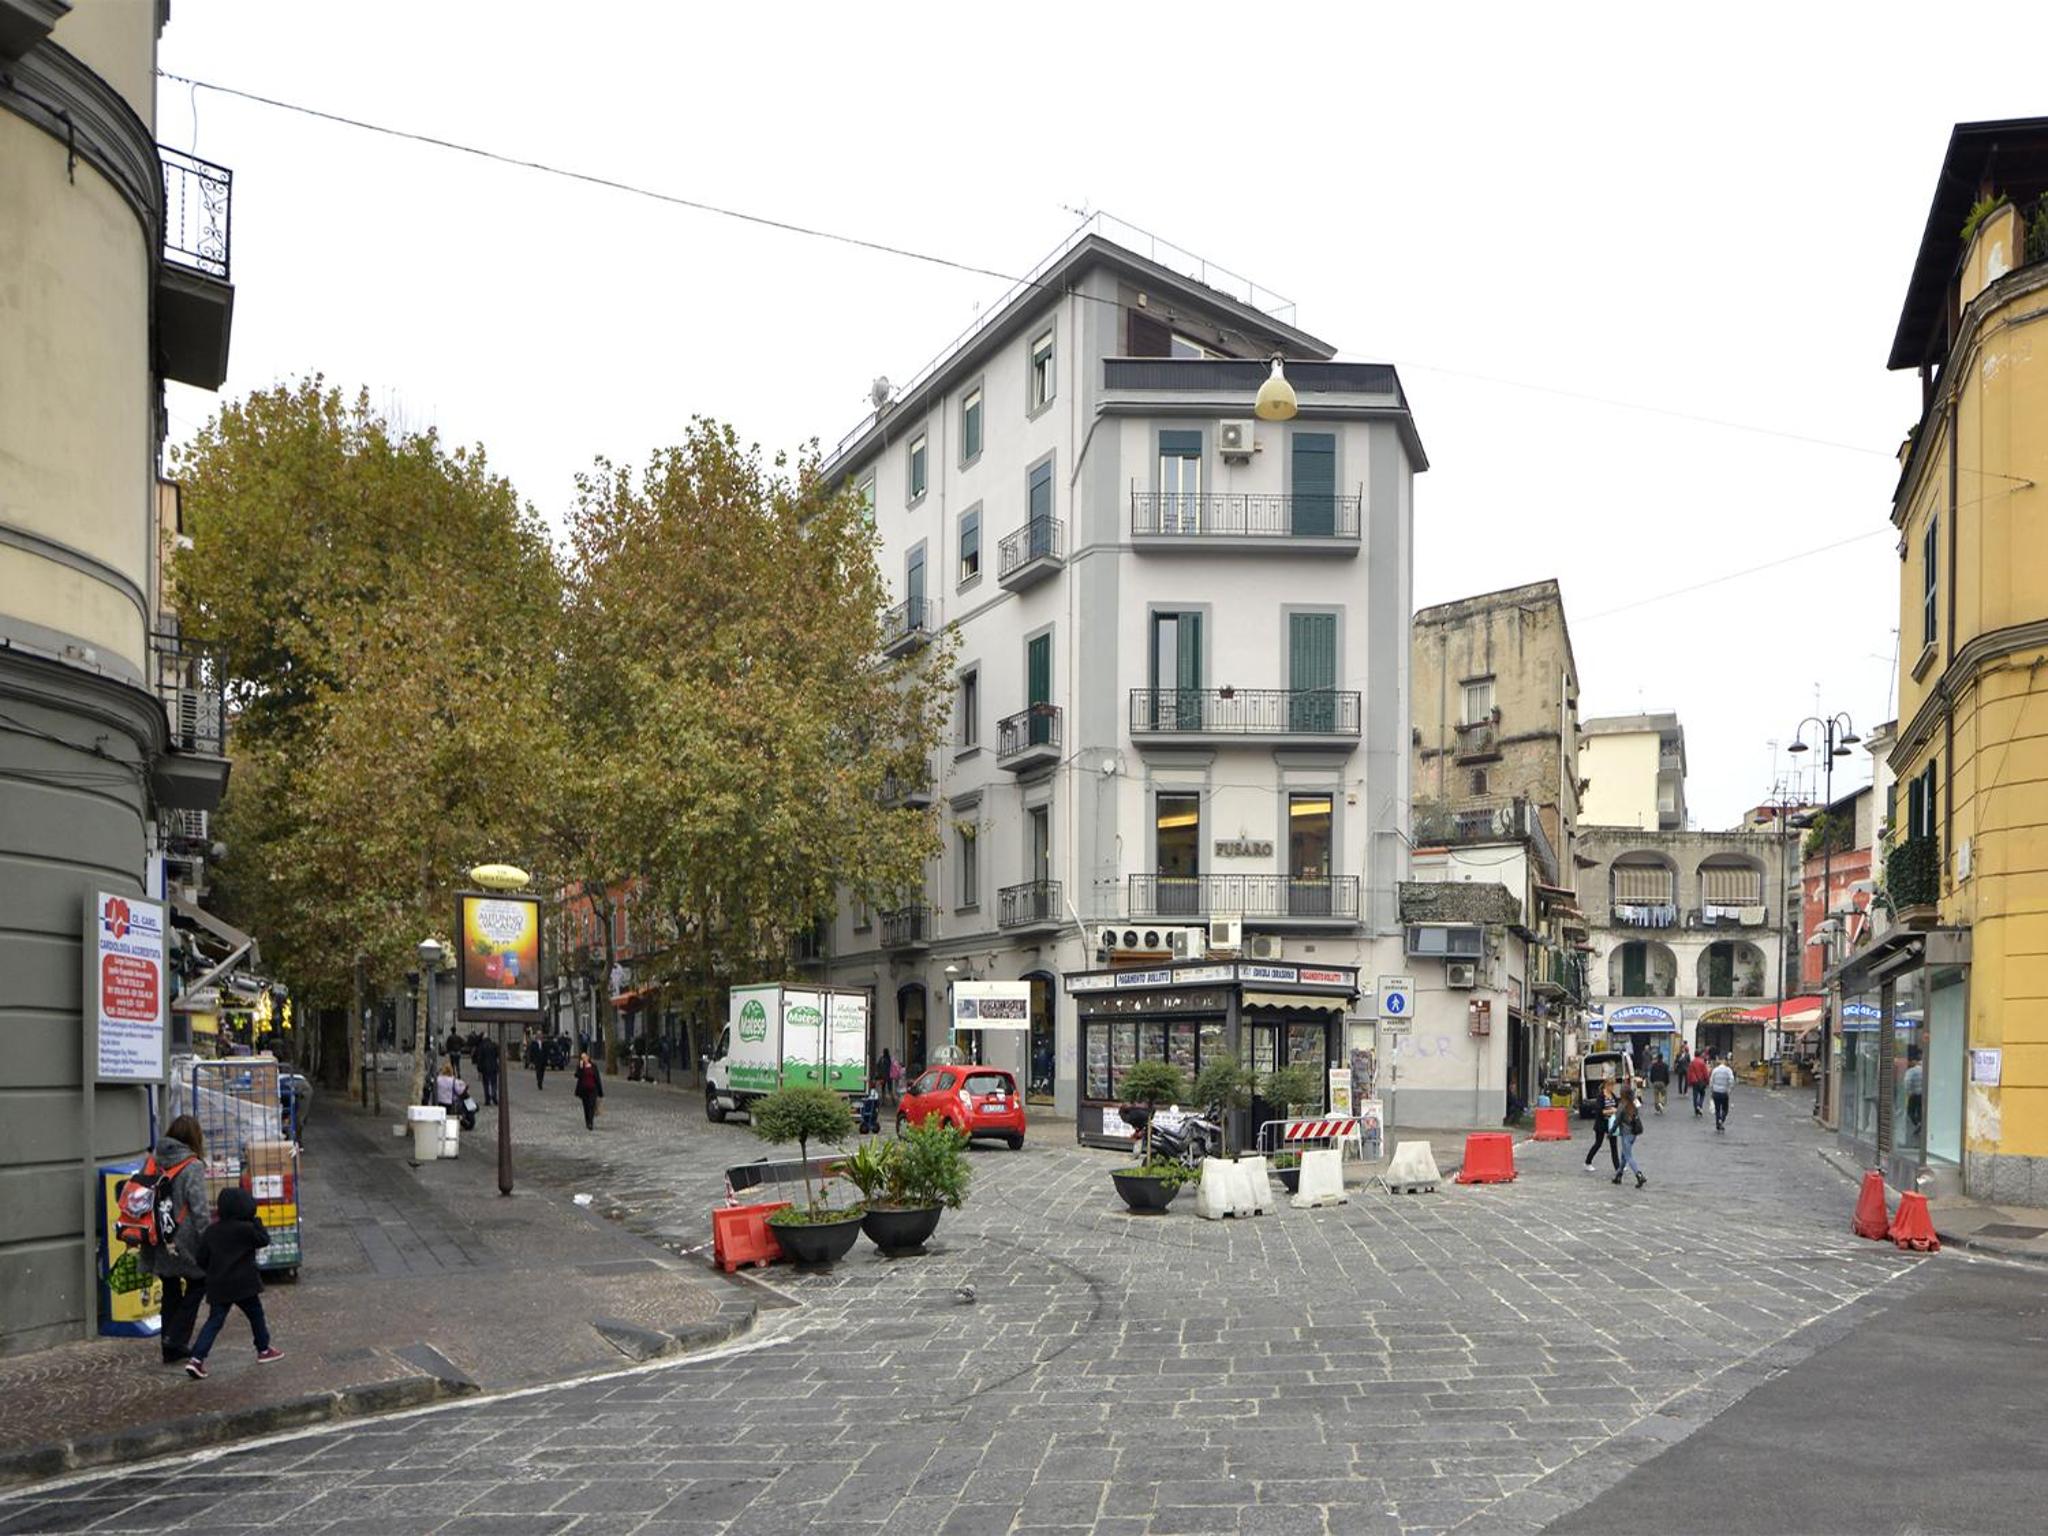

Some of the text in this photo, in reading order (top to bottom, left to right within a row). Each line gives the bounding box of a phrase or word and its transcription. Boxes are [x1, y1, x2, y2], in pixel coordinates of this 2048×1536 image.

[1214, 841, 1274, 857] FUSARO
[786, 1012, 821, 1025] Matese
[1612, 1006, 1667, 1020] TABACCHERIA
[740, 1016, 766, 1036] Matese
